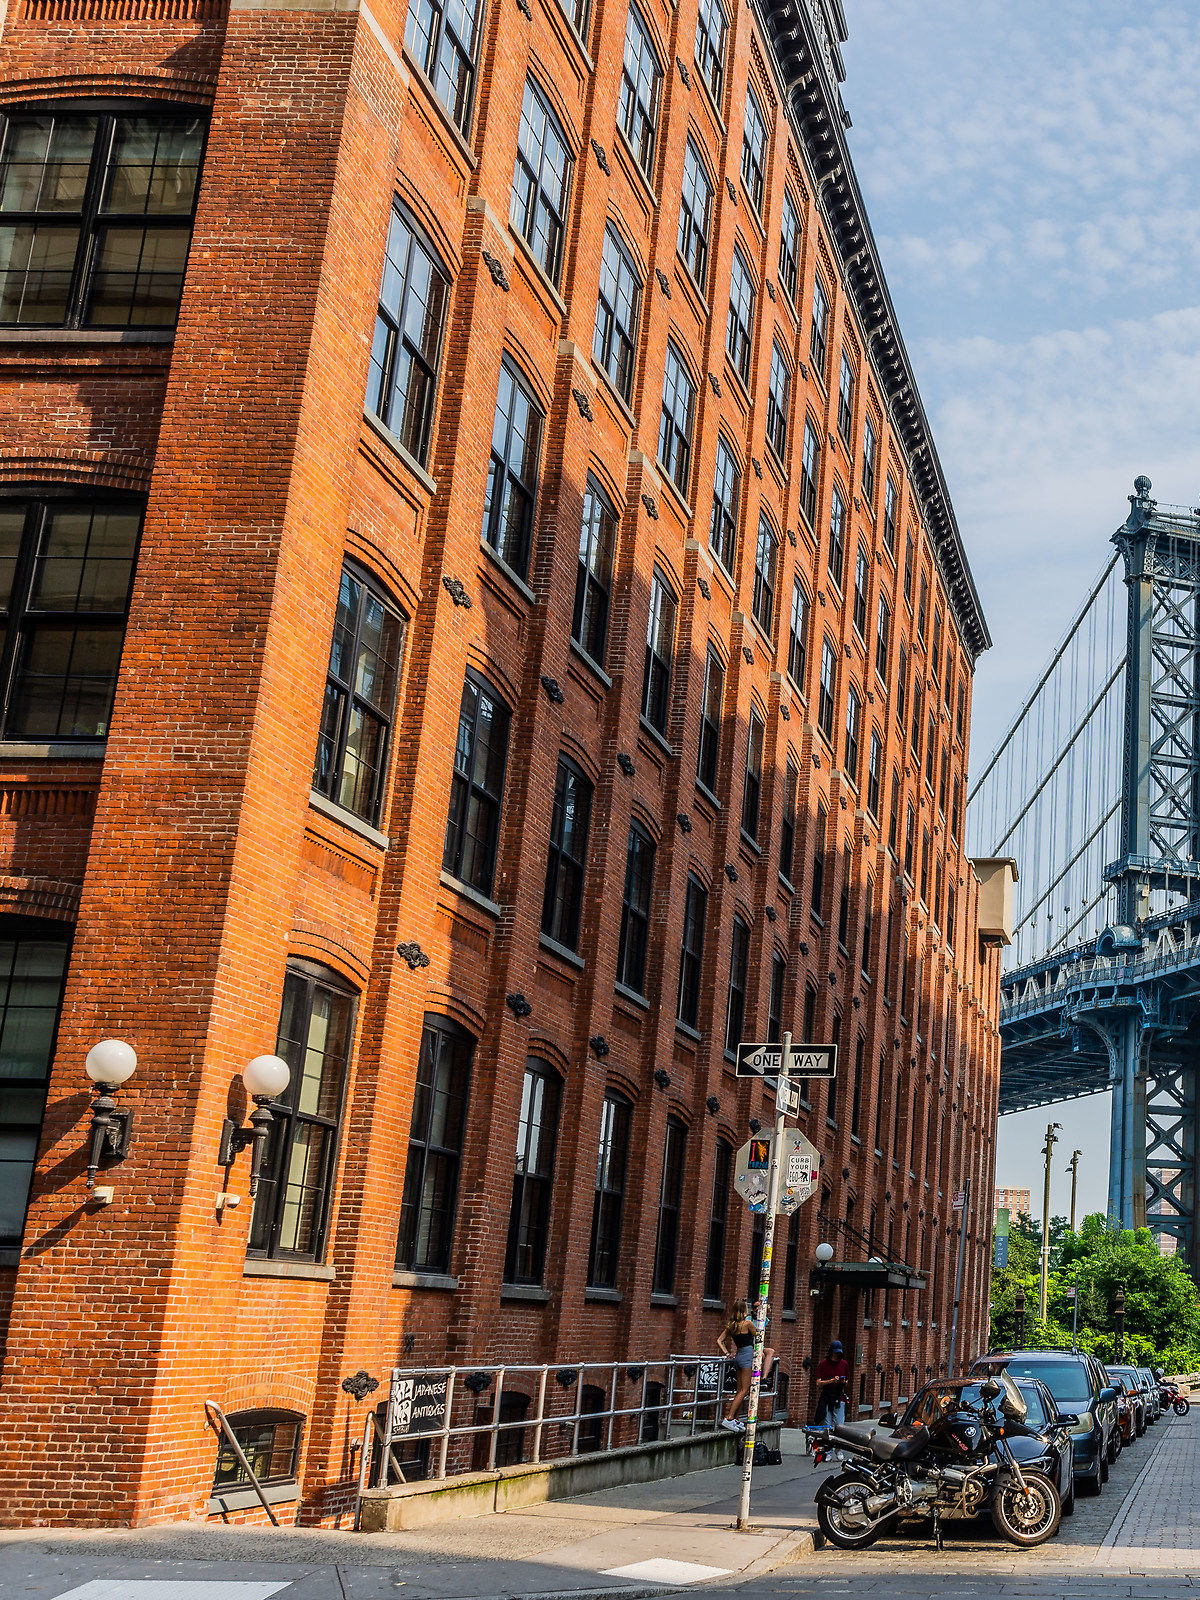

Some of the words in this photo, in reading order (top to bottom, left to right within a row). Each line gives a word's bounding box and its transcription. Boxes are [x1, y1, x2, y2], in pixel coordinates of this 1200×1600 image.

[753, 1054, 780, 1067] ONE
[794, 1054, 823, 1067] WAY
[411, 1381, 447, 1402] JAPANESE
